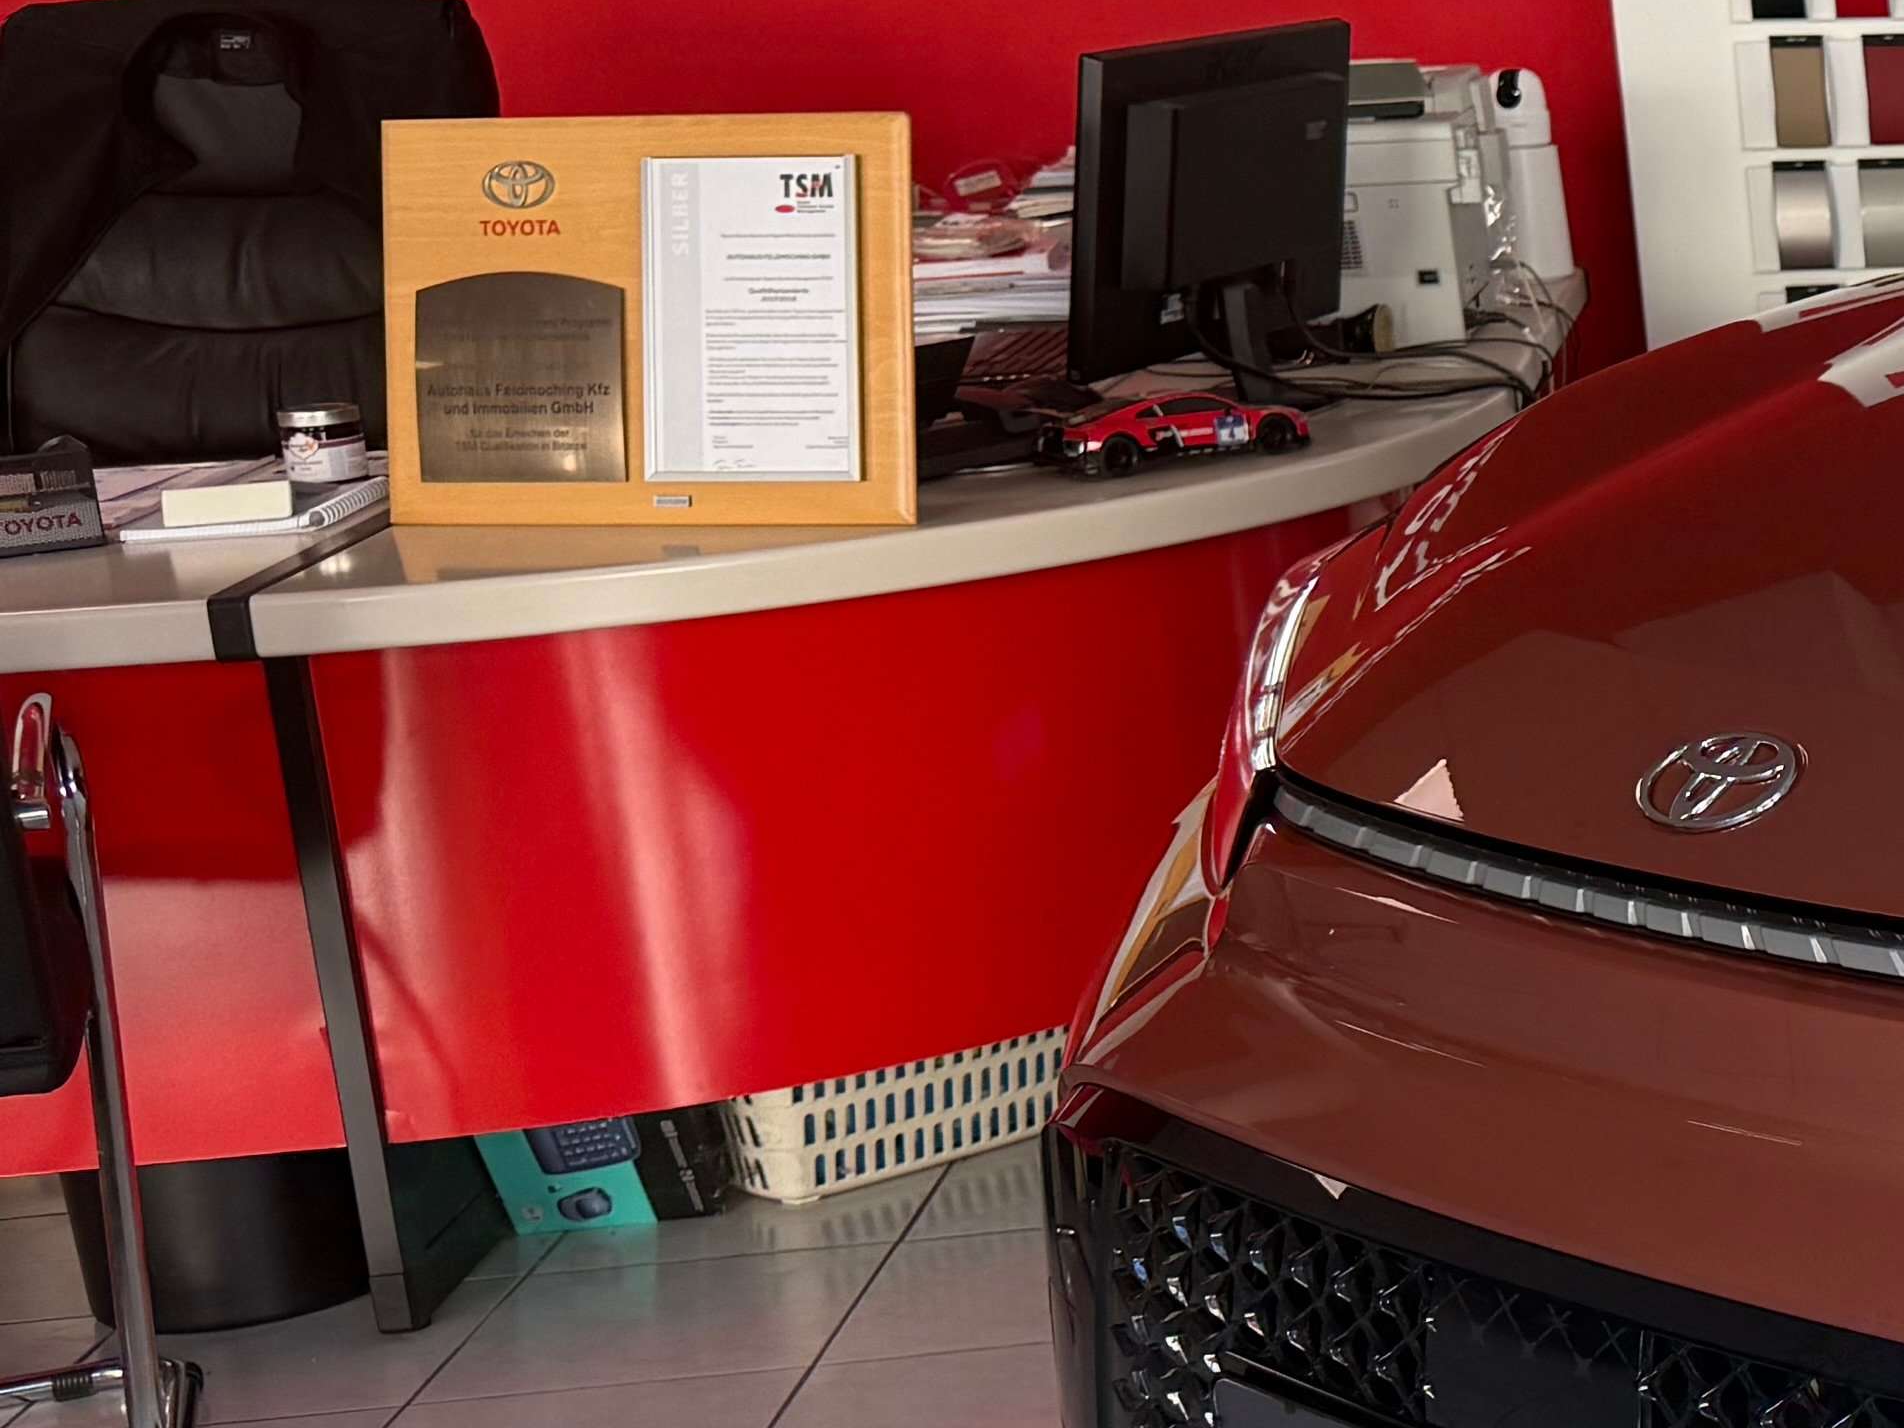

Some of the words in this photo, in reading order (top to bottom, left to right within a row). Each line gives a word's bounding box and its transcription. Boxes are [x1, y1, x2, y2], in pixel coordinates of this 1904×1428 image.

[779, 172, 834, 198] TSM
[671, 172, 690, 257] SILBER
[478, 218, 563, 239] TOYOTA
[587, 382, 612, 396] Kfz
[550, 400, 594, 414] GmbH
